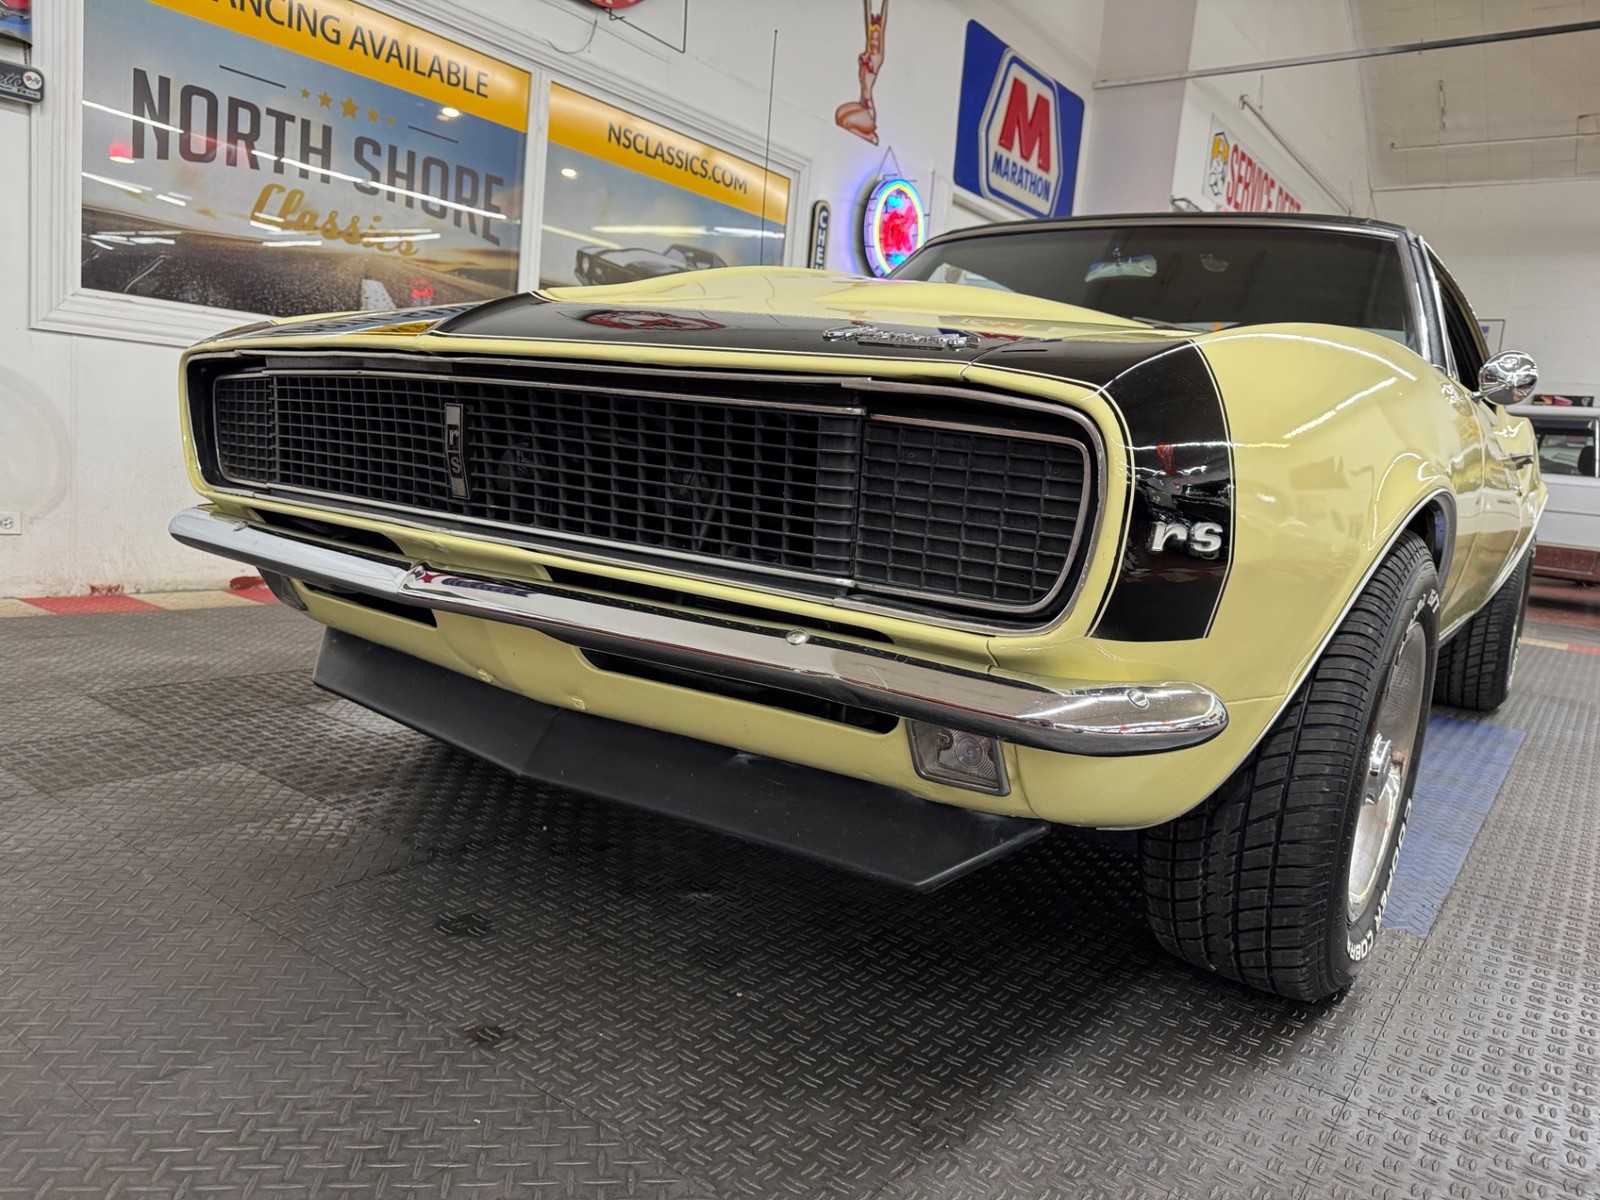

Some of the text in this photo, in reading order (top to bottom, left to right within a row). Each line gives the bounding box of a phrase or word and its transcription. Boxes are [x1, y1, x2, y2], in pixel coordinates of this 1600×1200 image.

[348, 25, 489, 98] AVAILABLE
[132, 67, 504, 247] NORTH SHORE
[608, 121, 748, 194] NSCLASSICS.COM
[998, 77, 1051, 174] M
[991, 150, 1051, 202] MARATHON
[1226, 143, 1276, 213] SERVICE
[250, 183, 420, 257] Classics
[814, 209, 829, 270] CHE
[1148, 520, 1224, 553] rs
